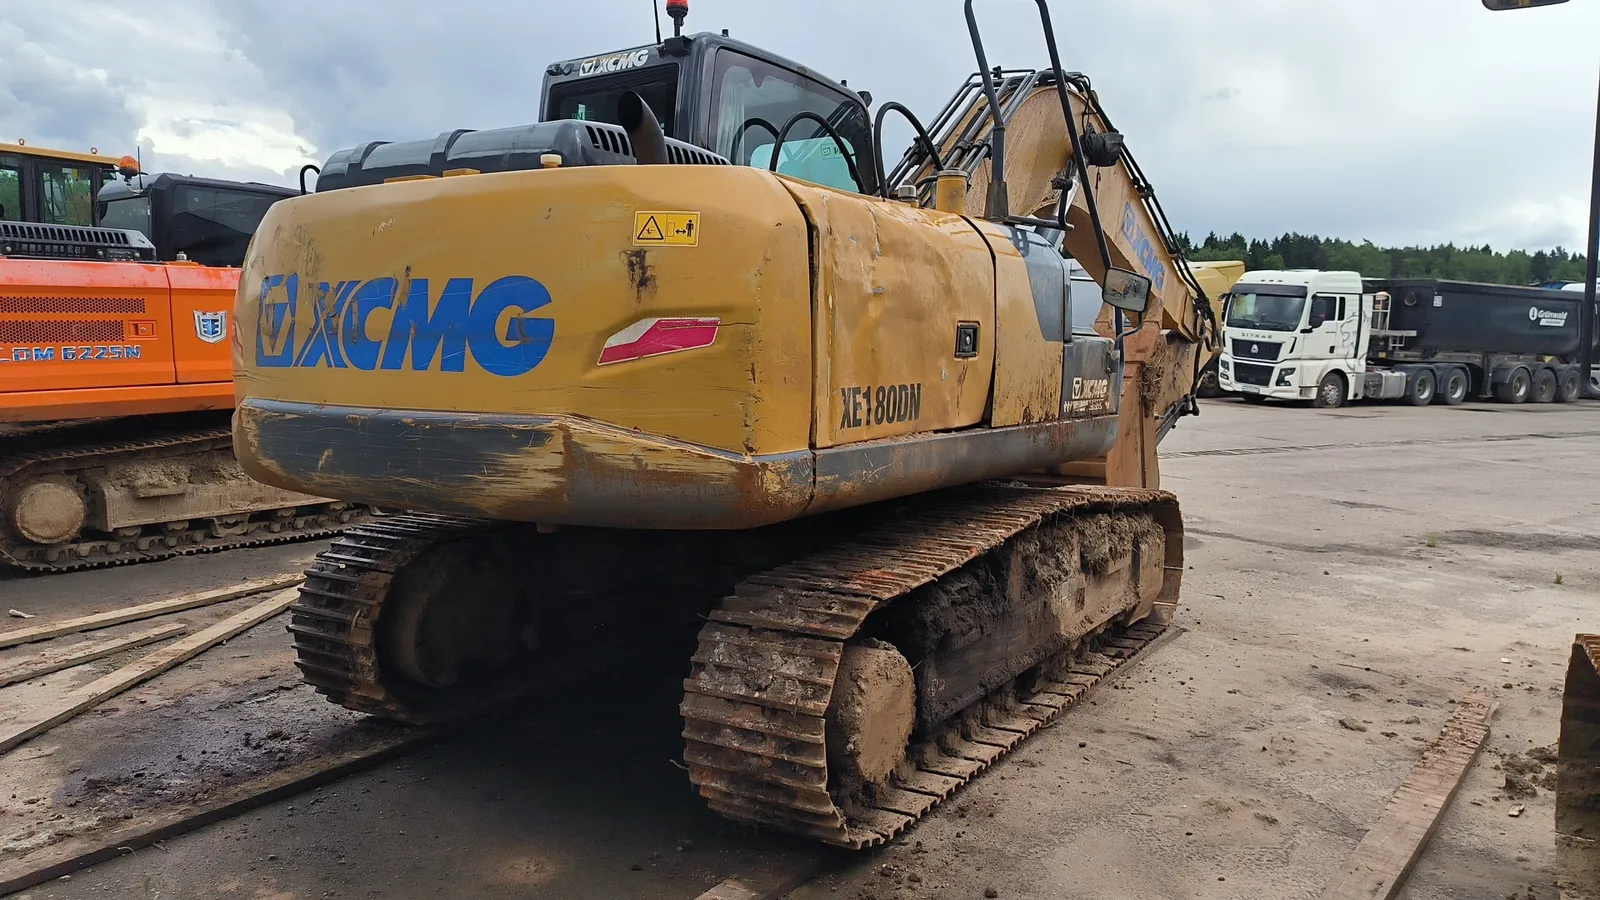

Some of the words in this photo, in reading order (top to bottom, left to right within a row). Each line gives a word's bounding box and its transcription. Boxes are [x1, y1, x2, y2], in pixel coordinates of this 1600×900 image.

[594, 49, 649, 74] XCMG
[1132, 223, 1165, 291] XCMG
[296, 275, 555, 377] XCMG
[61, 345, 141, 360] 6225N
[1081, 378, 1108, 398] XCMG
[840, 383, 922, 429] XE180DN
